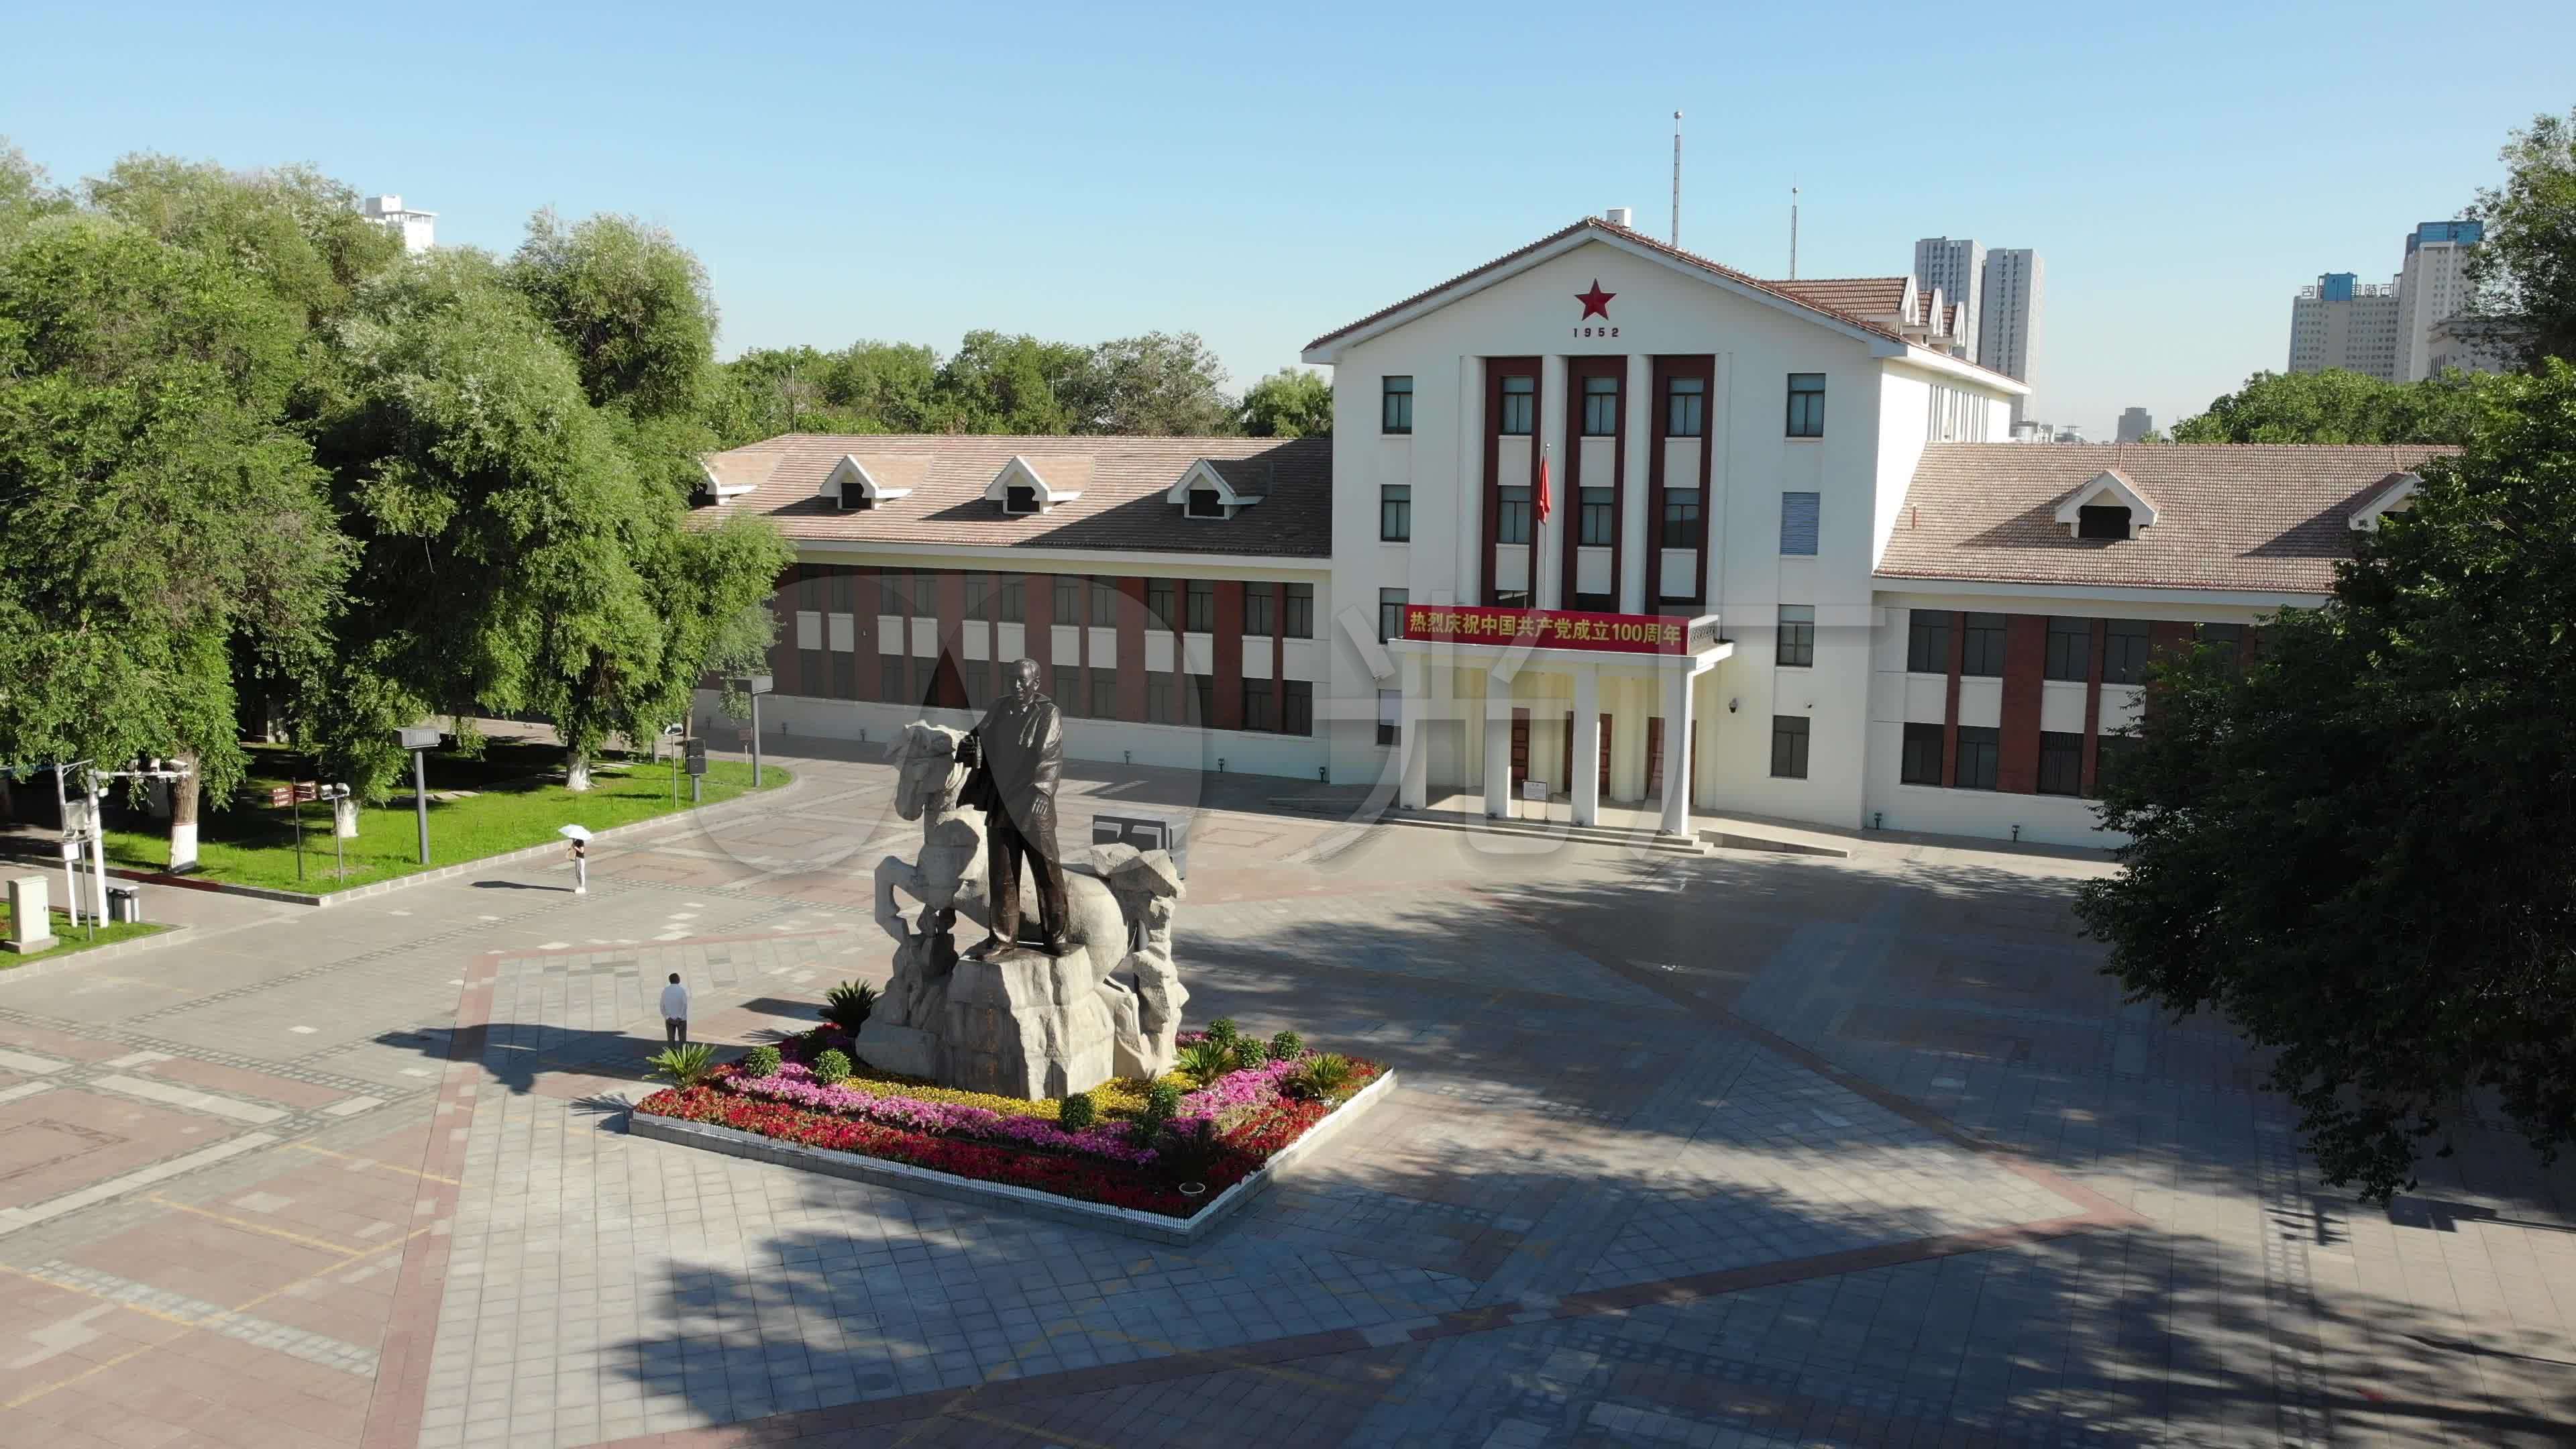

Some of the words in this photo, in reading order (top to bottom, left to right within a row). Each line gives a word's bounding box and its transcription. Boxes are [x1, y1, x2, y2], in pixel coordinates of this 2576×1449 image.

[1573, 327, 1619, 337] 1952
[1410, 611, 1681, 646] 热烈庆祝中国共产党成立100周年
